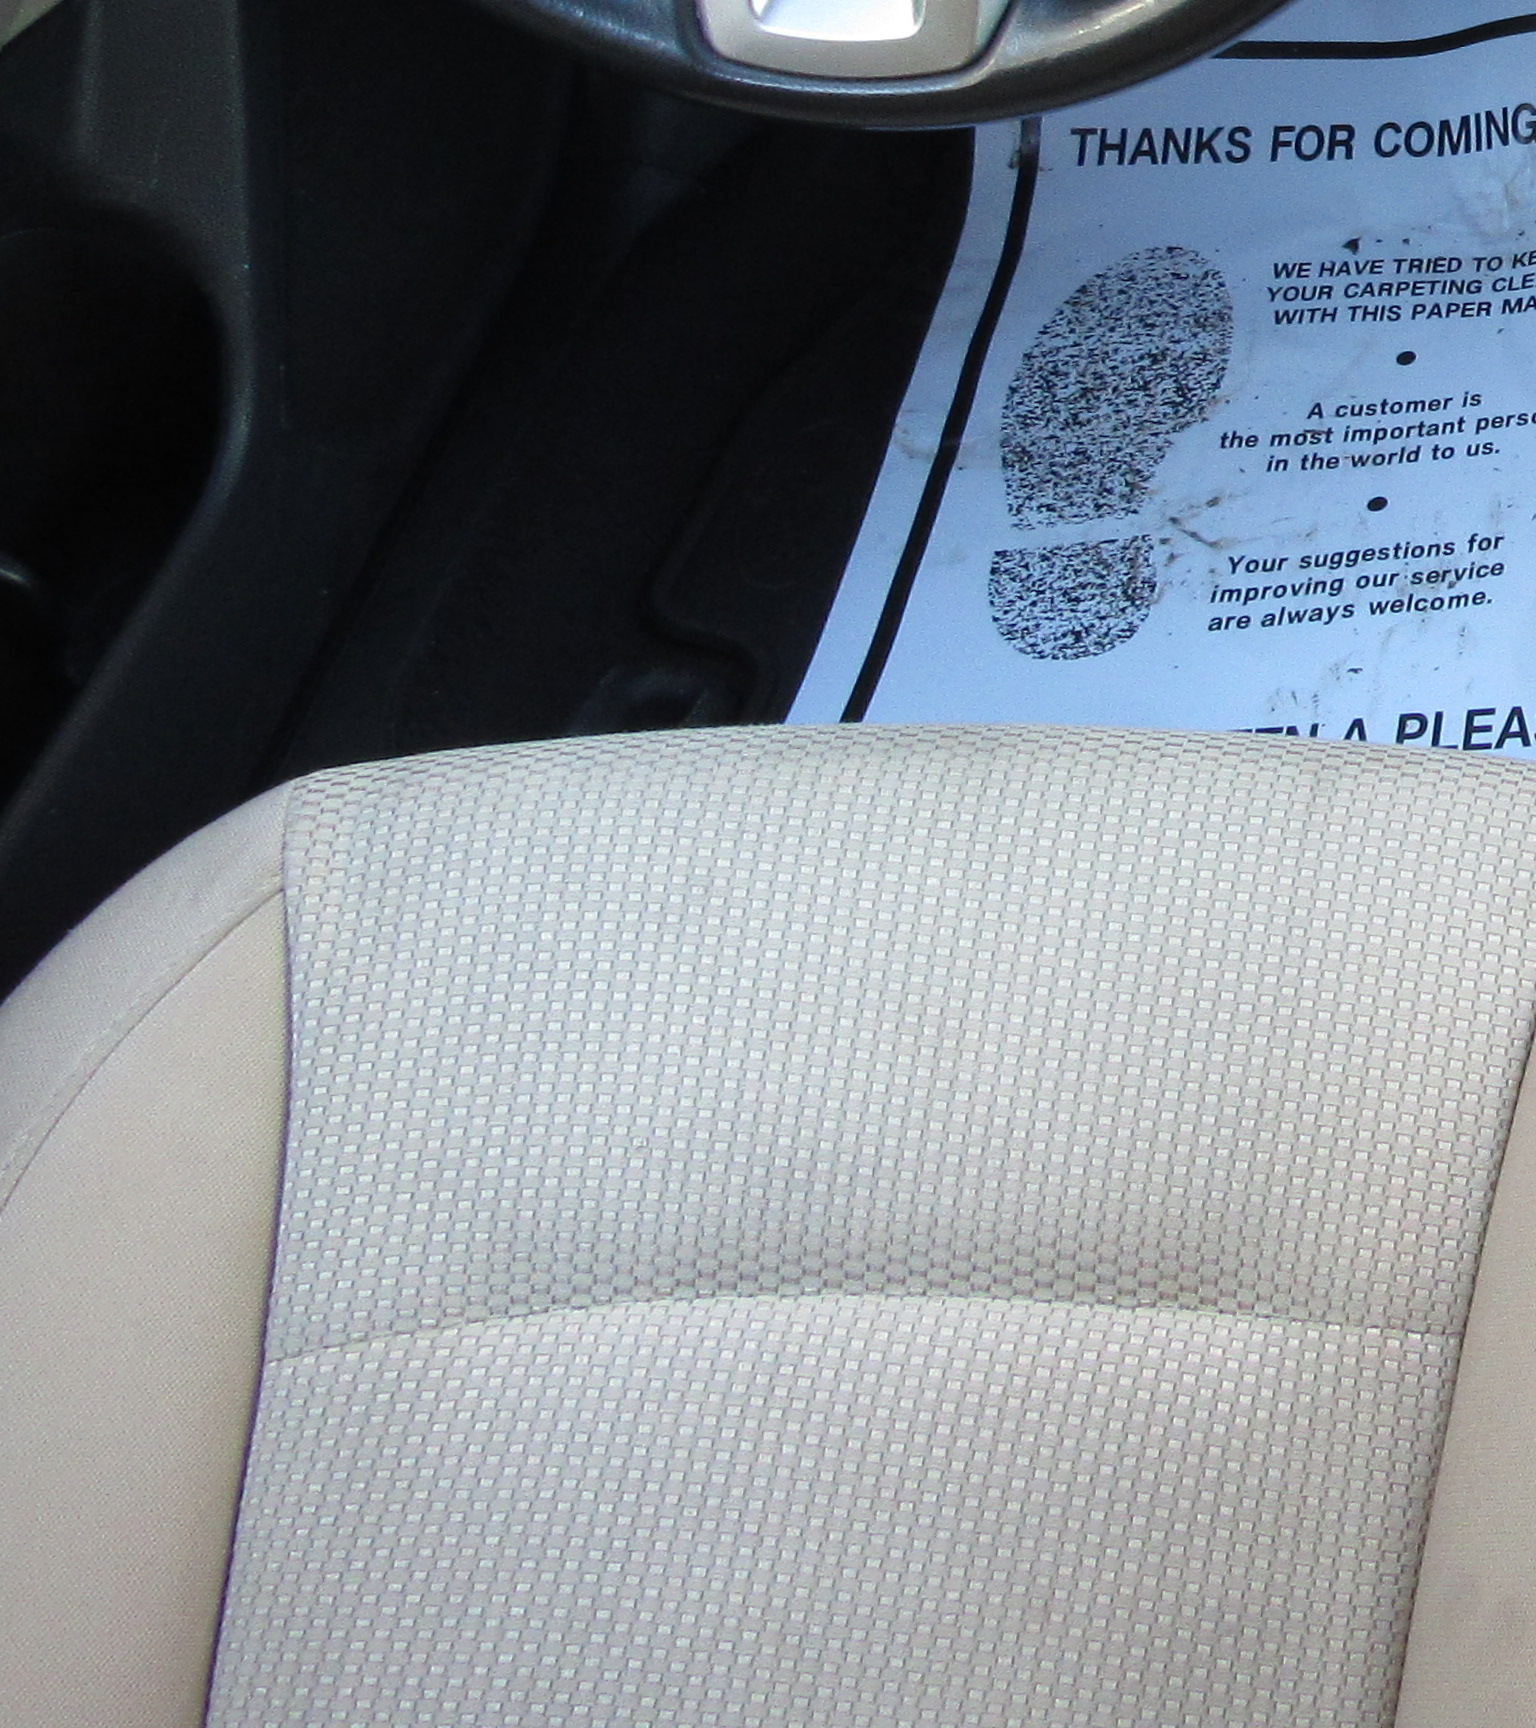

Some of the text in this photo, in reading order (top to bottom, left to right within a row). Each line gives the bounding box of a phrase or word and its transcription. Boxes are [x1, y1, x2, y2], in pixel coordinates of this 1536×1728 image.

[1070, 126, 1252, 166] THANKS
[1270, 124, 1355, 162] FOR
[1273, 262, 1312, 279] WE
[1318, 260, 1385, 278] HAVE
[1393, 257, 1462, 274] TRIED
[1473, 256, 1503, 272] TO
[1267, 285, 1333, 303] YOUR
[1344, 279, 1482, 299] CARPETING
[1274, 307, 1337, 325] WITH
[1348, 305, 1402, 322] THIS
[1411, 301, 1492, 320] PAPER
[1307, 391, 1482, 420] A customer is
[1219, 431, 1258, 450] the
[1270, 426, 1334, 447] most
[1343, 416, 1465, 445] important
[1266, 441, 1500, 472] in the world to us.
[1227, 533, 1505, 575] Your suggestions for
[1210, 560, 1505, 605] improving our service
[1207, 590, 1493, 631] are always welcome.
